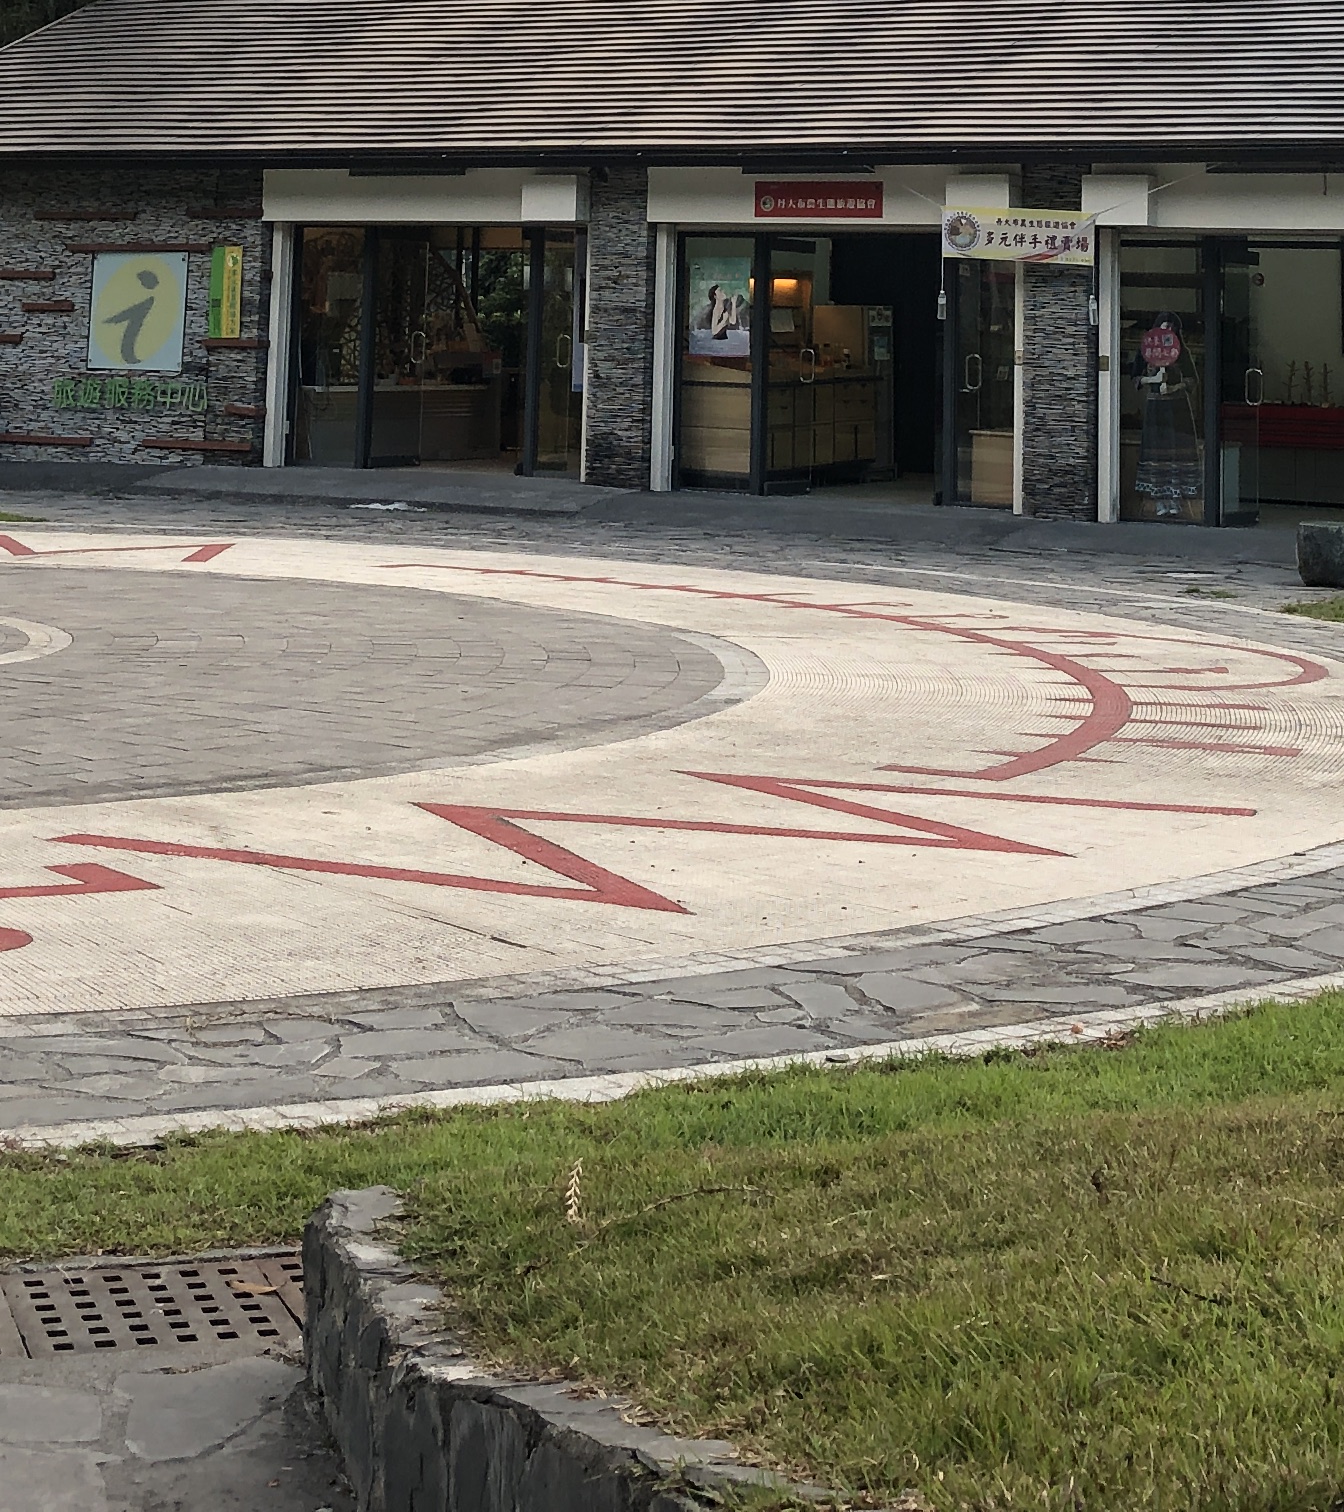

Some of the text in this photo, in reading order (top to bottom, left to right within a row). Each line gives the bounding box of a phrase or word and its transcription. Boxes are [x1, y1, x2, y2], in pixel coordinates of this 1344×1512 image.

[984, 230, 1090, 253] 多元伴手禮賣場
[53, 378, 208, 412] 旅遊服務中心
